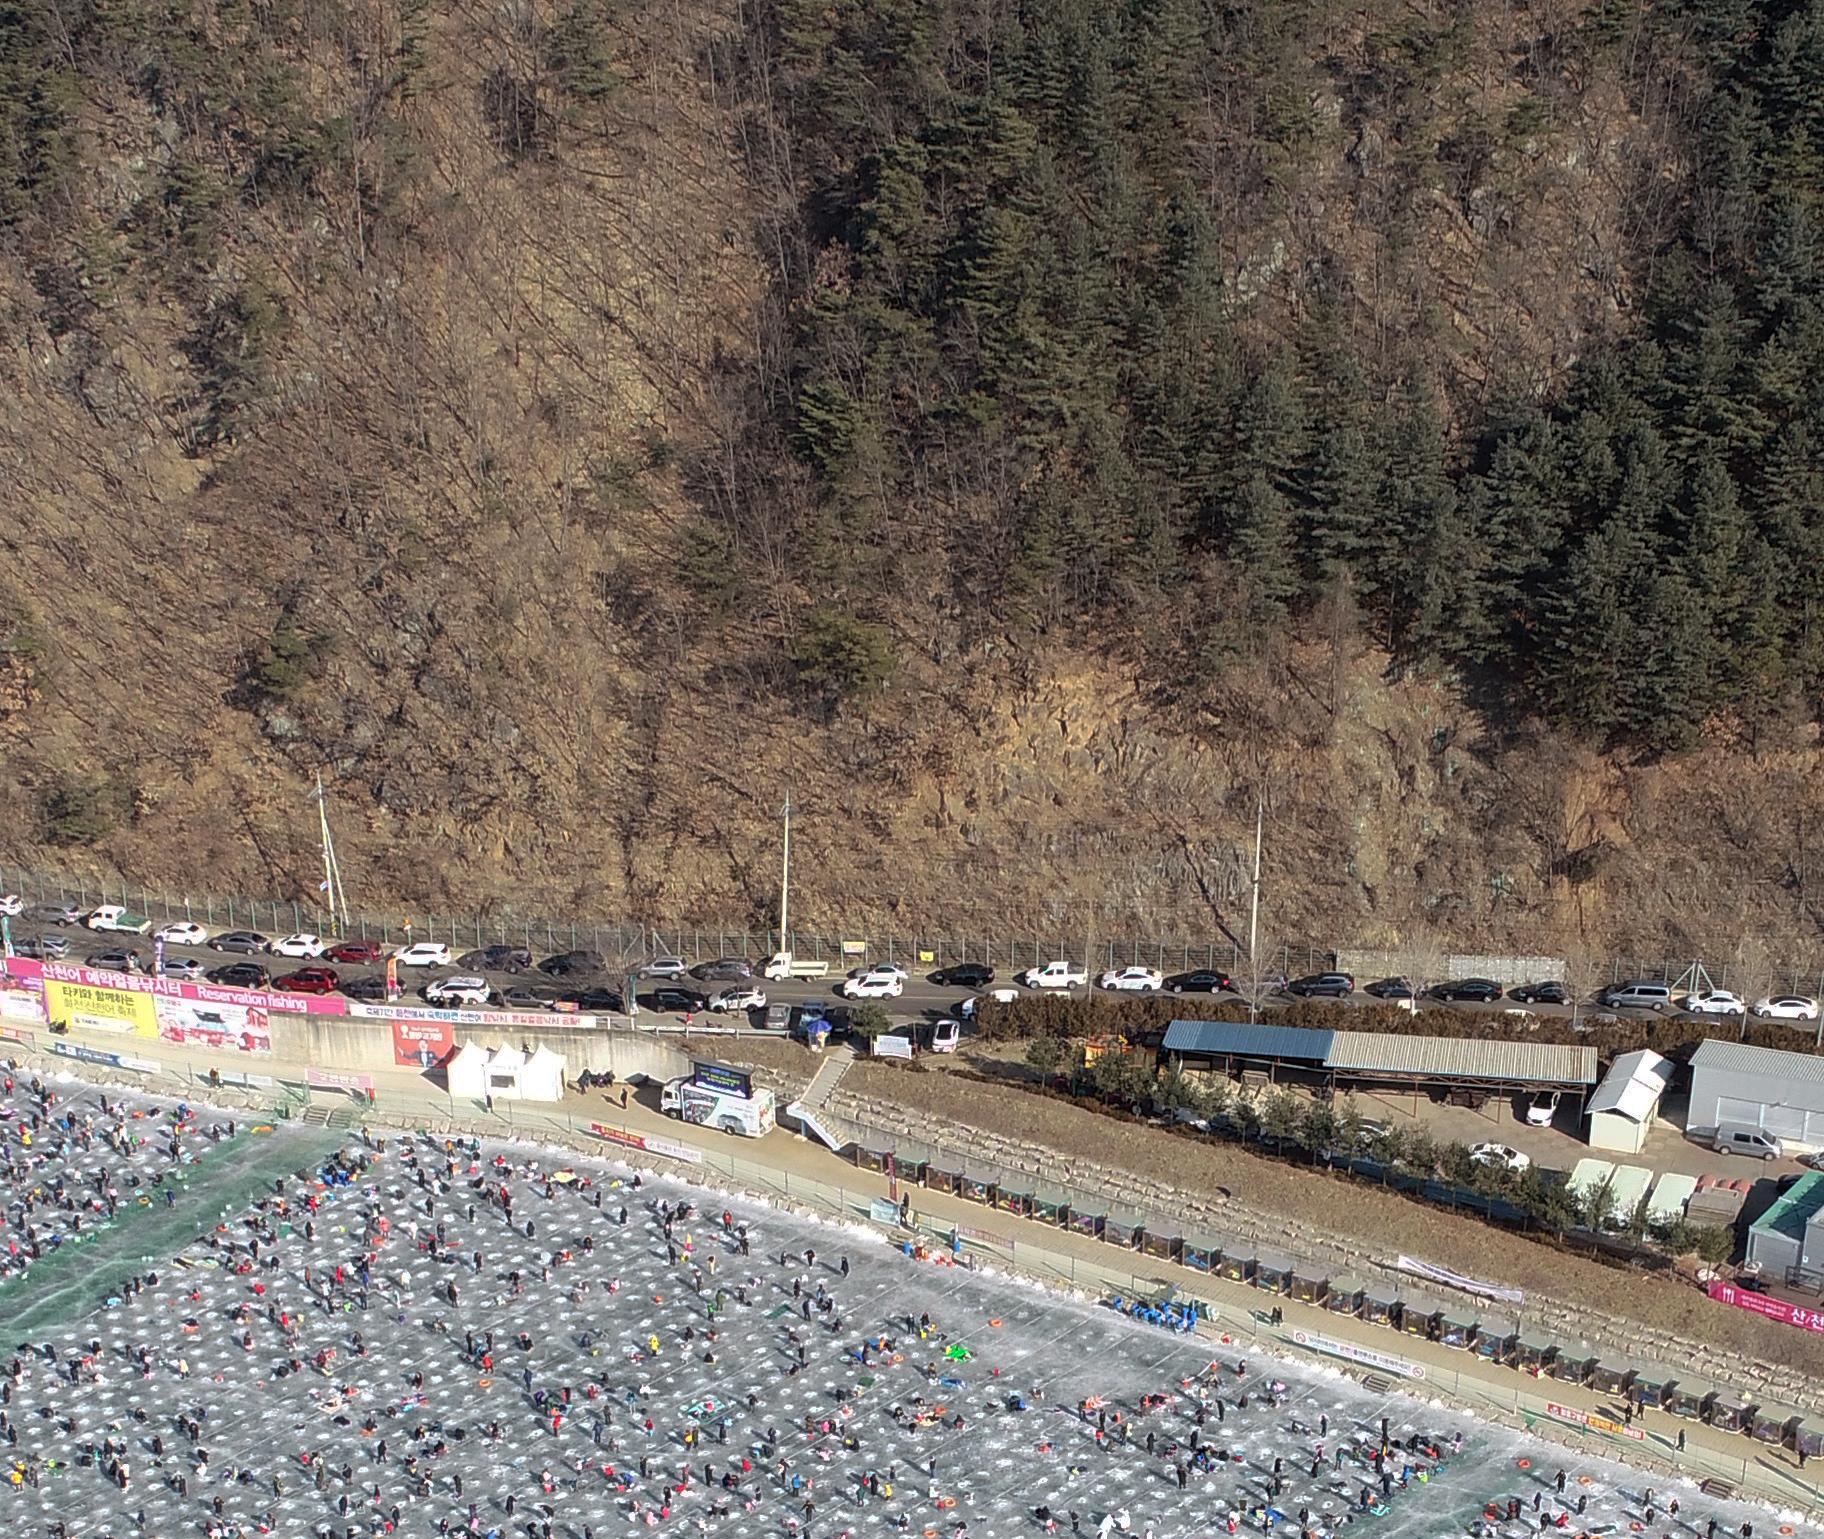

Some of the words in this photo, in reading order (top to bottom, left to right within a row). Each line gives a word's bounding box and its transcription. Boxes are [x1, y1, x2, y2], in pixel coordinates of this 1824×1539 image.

[41, 963, 81, 983] 산천어
[85, 969, 182, 997] 예약얼음낚시터
[62, 985, 92, 1001] 타키와
[95, 989, 134, 1005] 함께하는
[198, 987, 265, 1006] Reservation
[266, 993, 307, 1012] fishing
